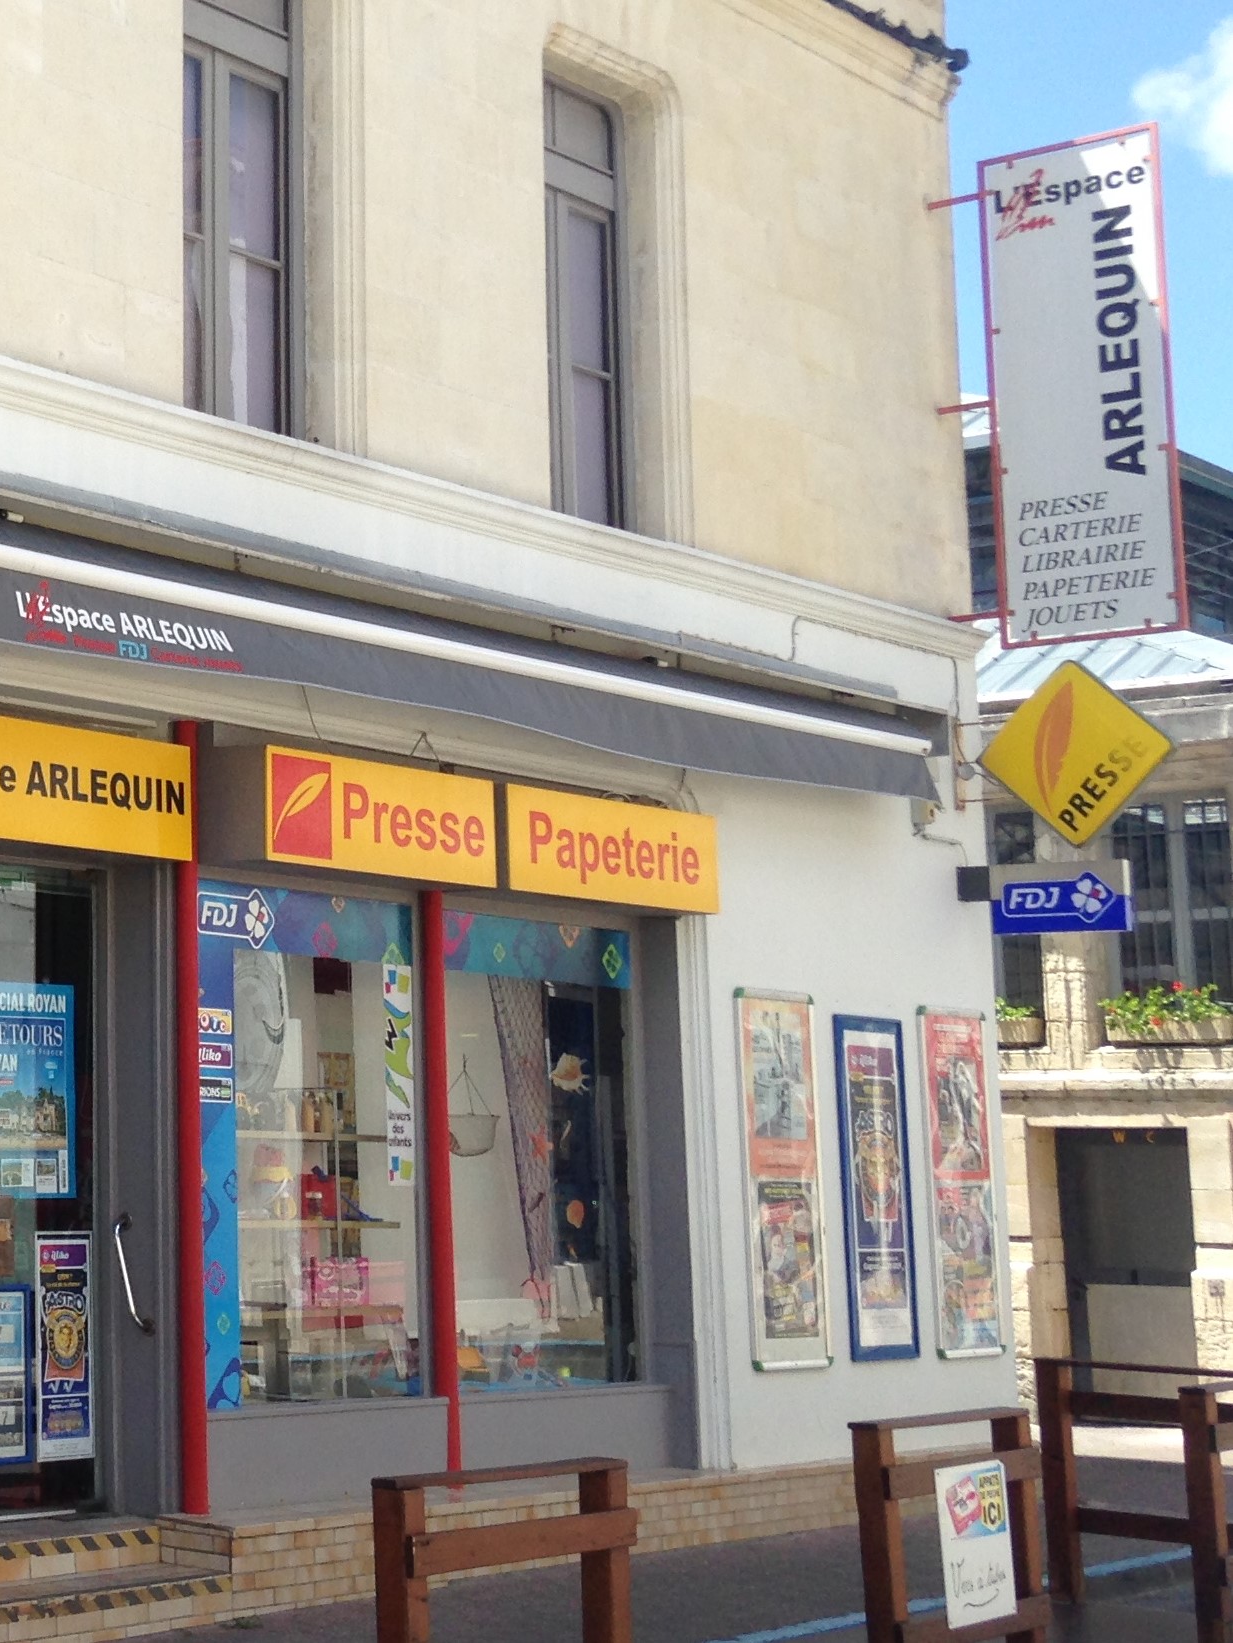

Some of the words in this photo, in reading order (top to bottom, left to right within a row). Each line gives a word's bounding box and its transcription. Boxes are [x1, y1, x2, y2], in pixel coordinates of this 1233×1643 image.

[1091, 204, 1146, 476] ARLEQUIN
[1018, 491, 1109, 522] PRESSE
[1018, 513, 1142, 547] CARTERIE
[1022, 540, 1146, 574] LIBRAIRIE
[1023, 567, 1157, 601] PAPETERIE
[118, 612, 234, 653] ARLEQUIN
[1021, 600, 1119, 633] JOUETS
[119, 640, 148, 660] FDJ
[26, 760, 185, 815] ARLEQUIN
[1058, 735, 1147, 833] PRESSE
[342, 782, 486, 857] Presse
[528, 810, 701, 885] Papeterie
[201, 901, 239, 928] FDJ
[1009, 886, 1060, 909] FDJ
[27, 992, 66, 1013] ROYAN
[982, 1501, 1002, 1525] ICI
